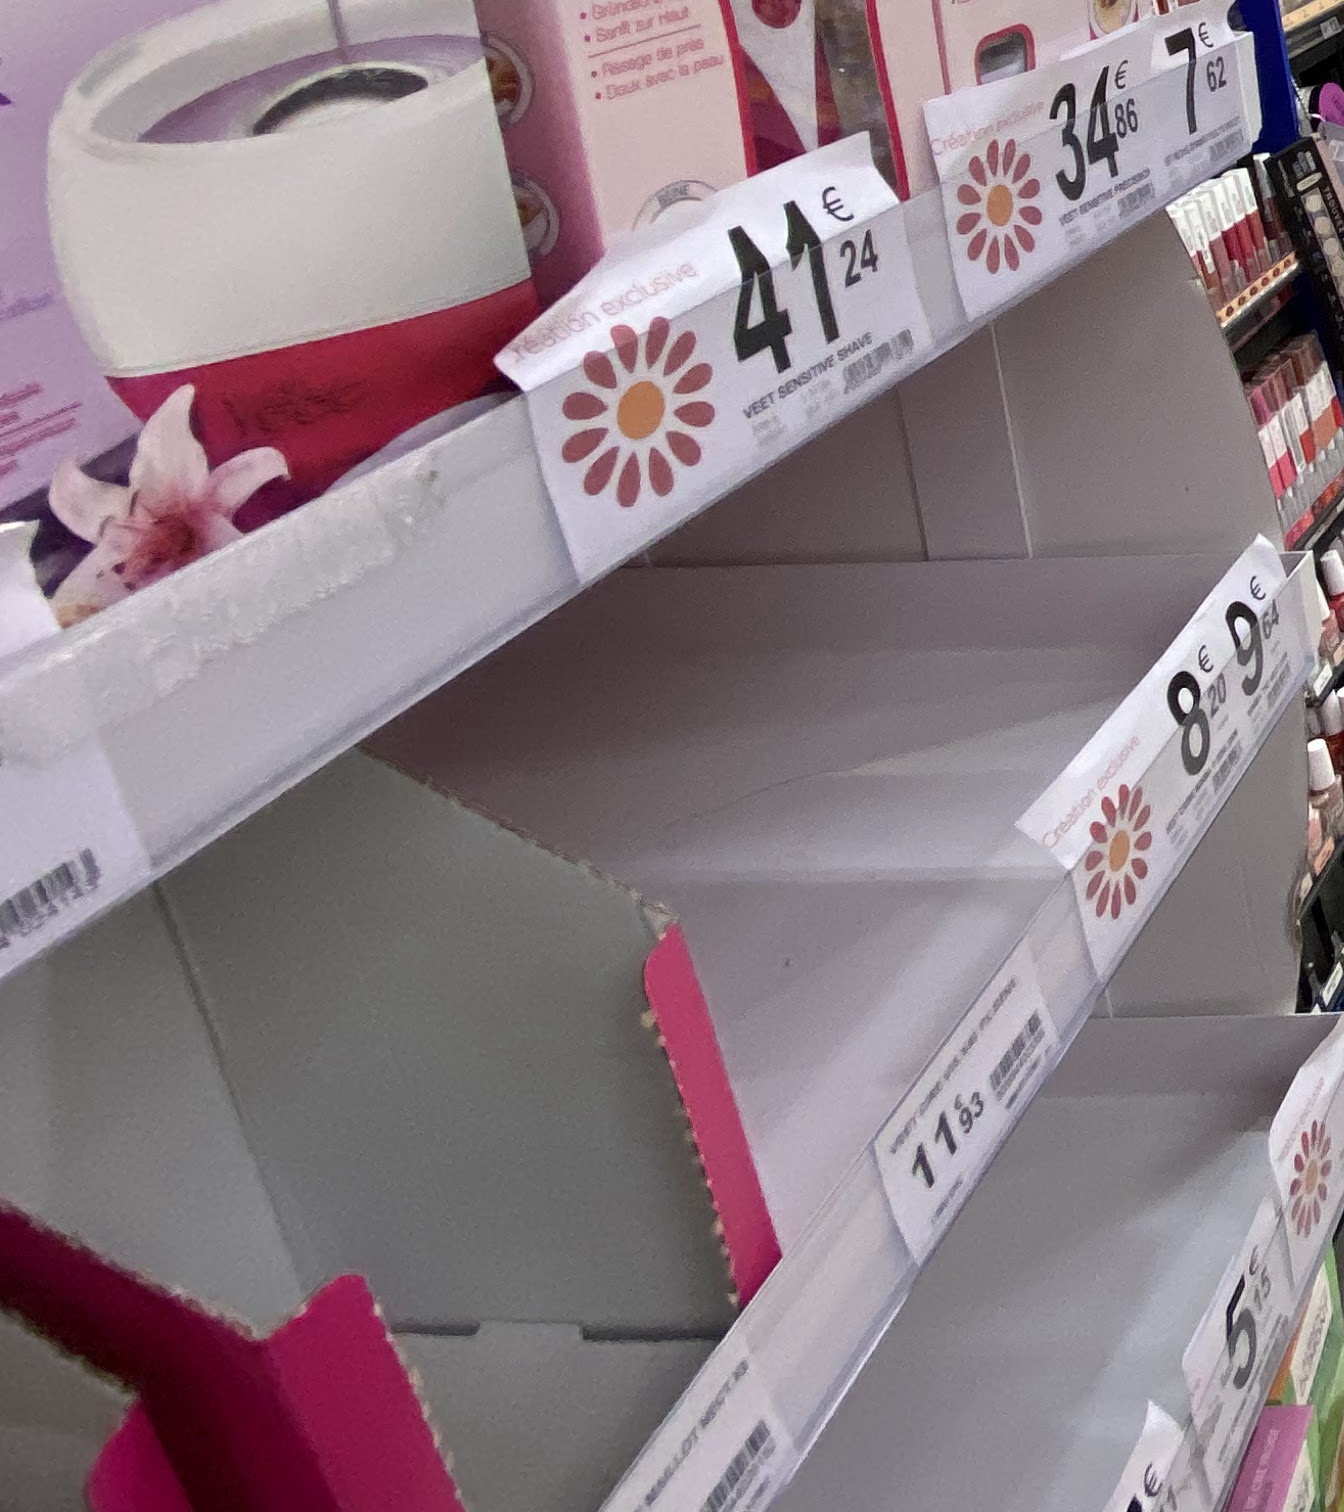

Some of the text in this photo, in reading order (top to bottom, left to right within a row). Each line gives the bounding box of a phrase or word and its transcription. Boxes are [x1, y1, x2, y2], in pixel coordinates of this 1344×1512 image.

[1049, 65, 1119, 201] 34
[1114, 98, 1138, 139] 86
[1164, 27, 1197, 135] 7
[1206, 56, 1227, 92] 62
[728, 187, 879, 374] 41 € 24
[742, 330, 873, 420] VEET SENSITIVE SHAVE
[1225, 600, 1263, 696] 9
[1167, 670, 1210, 776] 8
[912, 1091, 985, 1189] 11 93
[1225, 1273, 1257, 1390] 5
